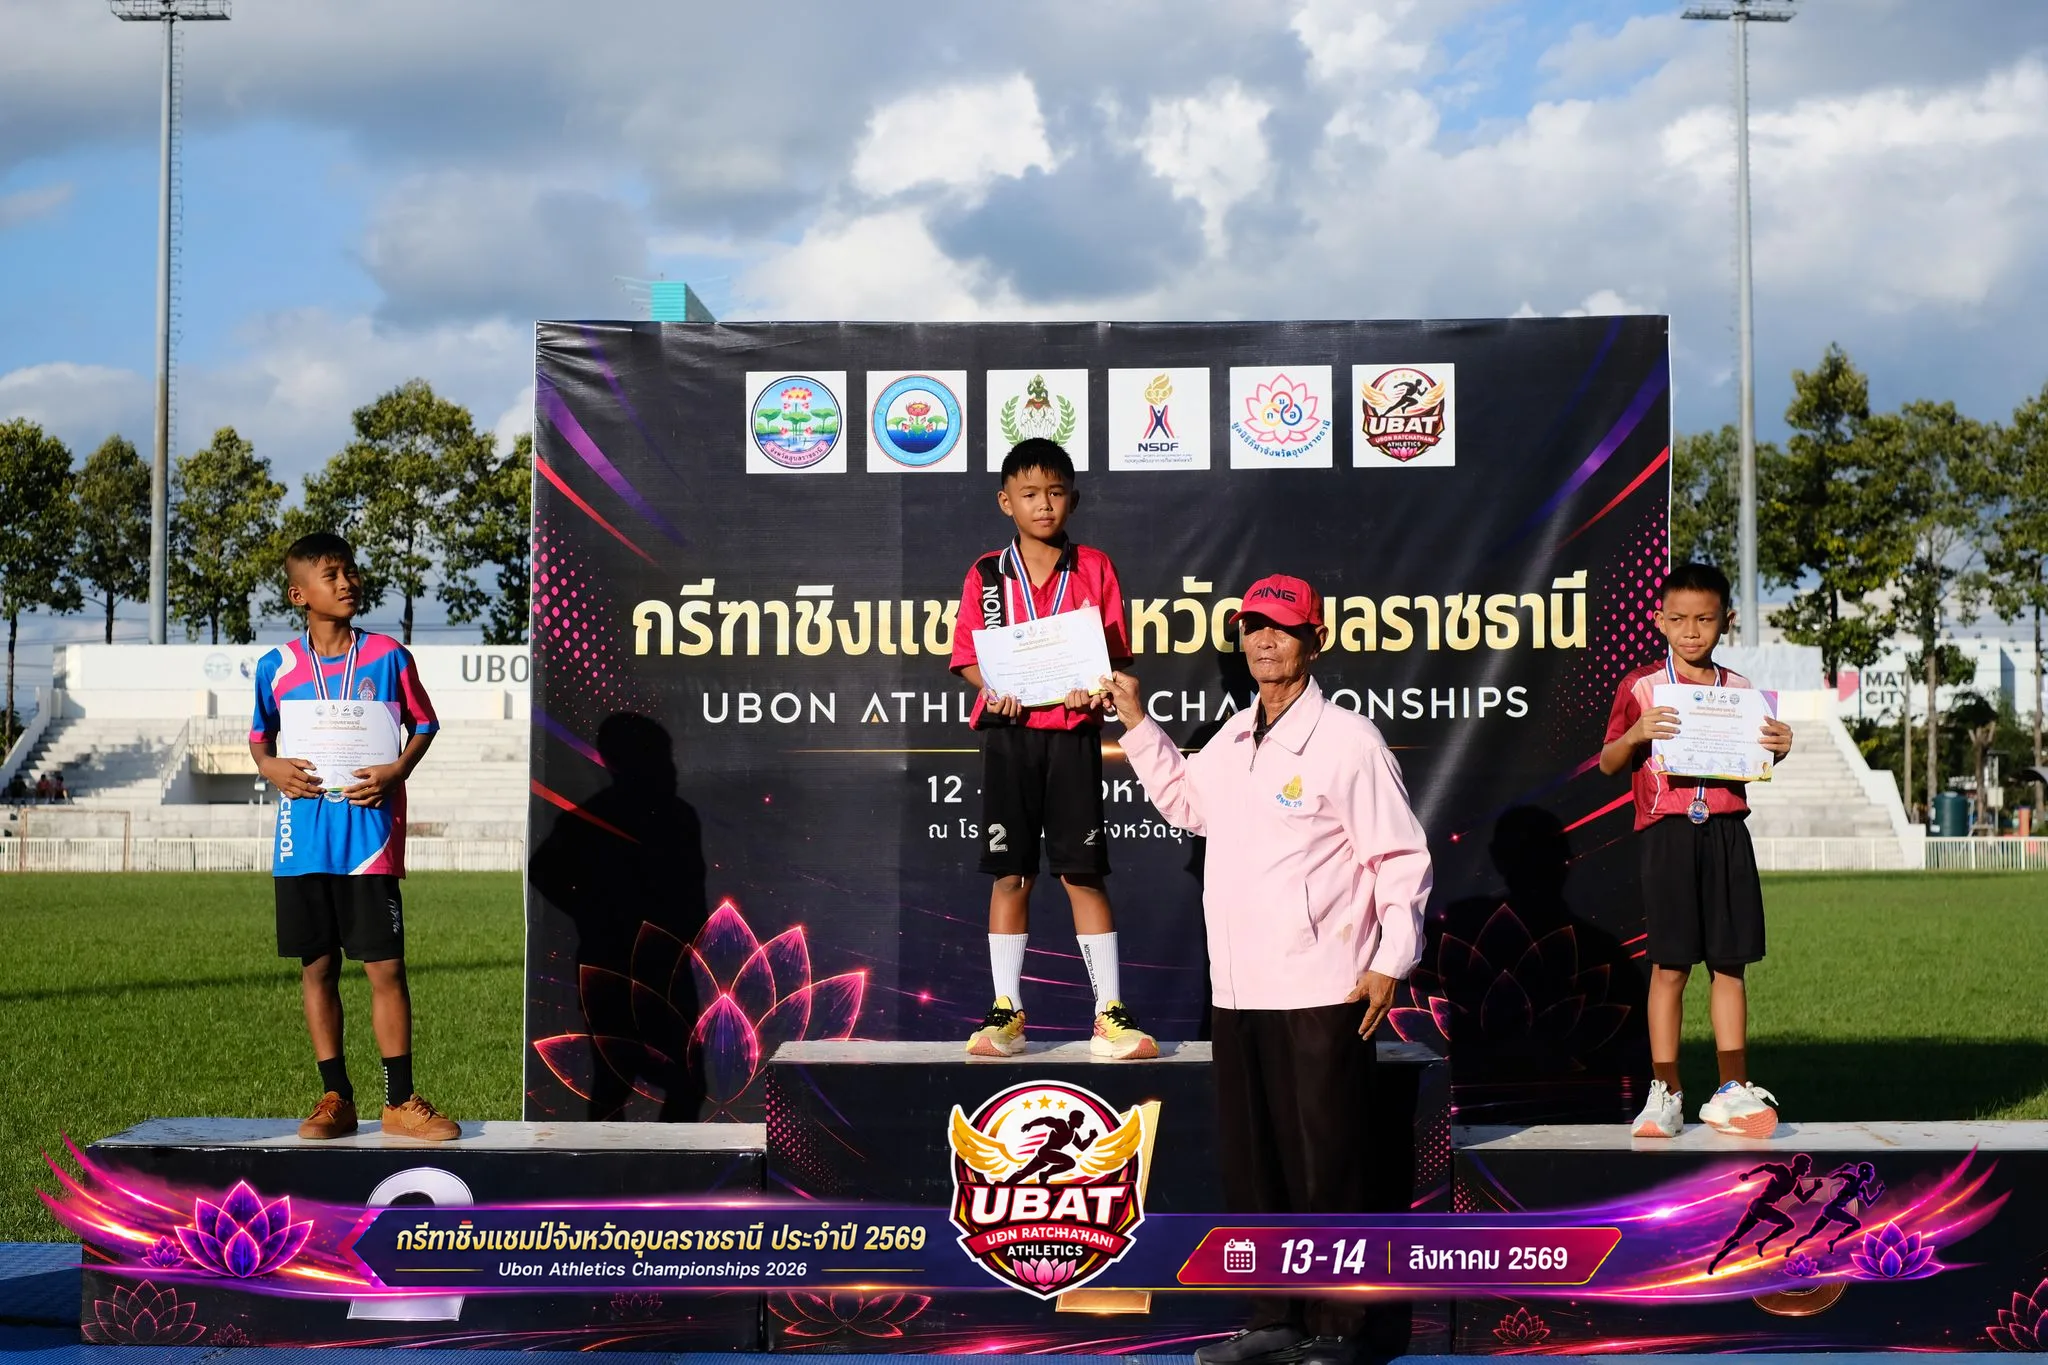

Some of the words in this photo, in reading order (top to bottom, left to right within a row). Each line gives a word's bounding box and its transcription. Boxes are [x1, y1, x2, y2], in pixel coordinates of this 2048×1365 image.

[1368, 416, 1439, 435] UBAT
[1138, 442, 1179, 452] NSDF
[1250, 587, 1297, 603] PING
[703, 692, 836, 724] UBON
[1147, 687, 1529, 722] CHAONSHIPS
[928, 776, 963, 803] 12
[928, 823, 948, 838] ณ
[987, 823, 1008, 853] 2
